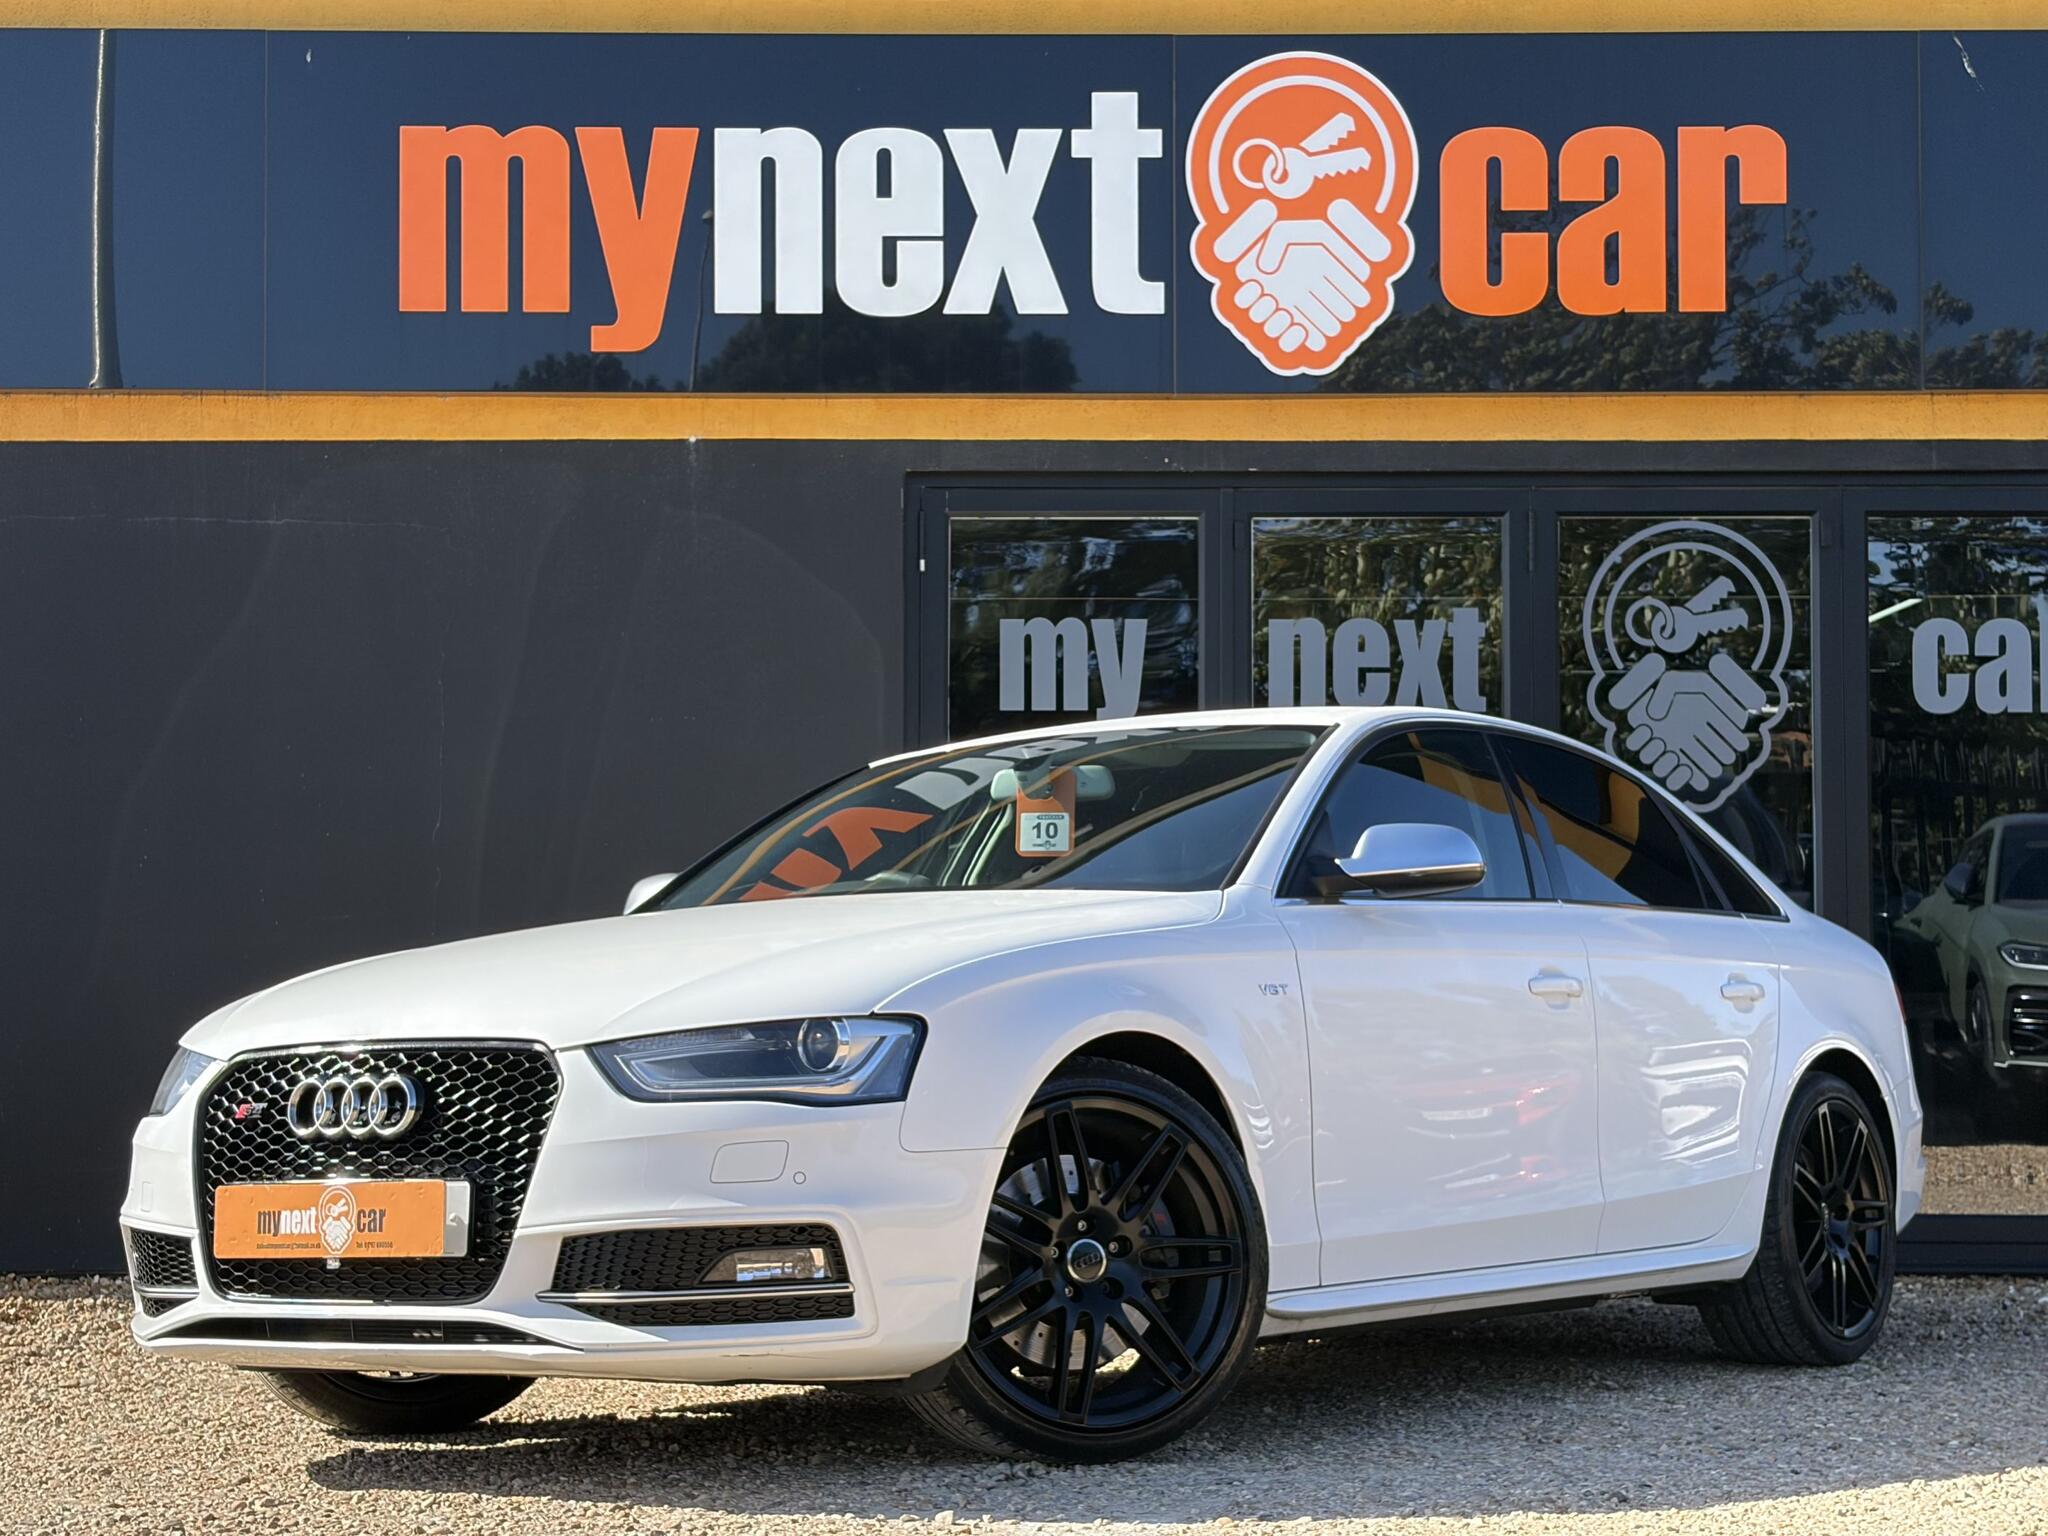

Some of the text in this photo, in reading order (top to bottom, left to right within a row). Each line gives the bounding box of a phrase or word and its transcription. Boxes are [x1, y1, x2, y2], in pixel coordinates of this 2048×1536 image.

[1439, 124, 1788, 316] car
[999, 607, 2048, 721] my next ca
[1032, 821, 1058, 839] 10
[356, 1208, 386, 1233] car
